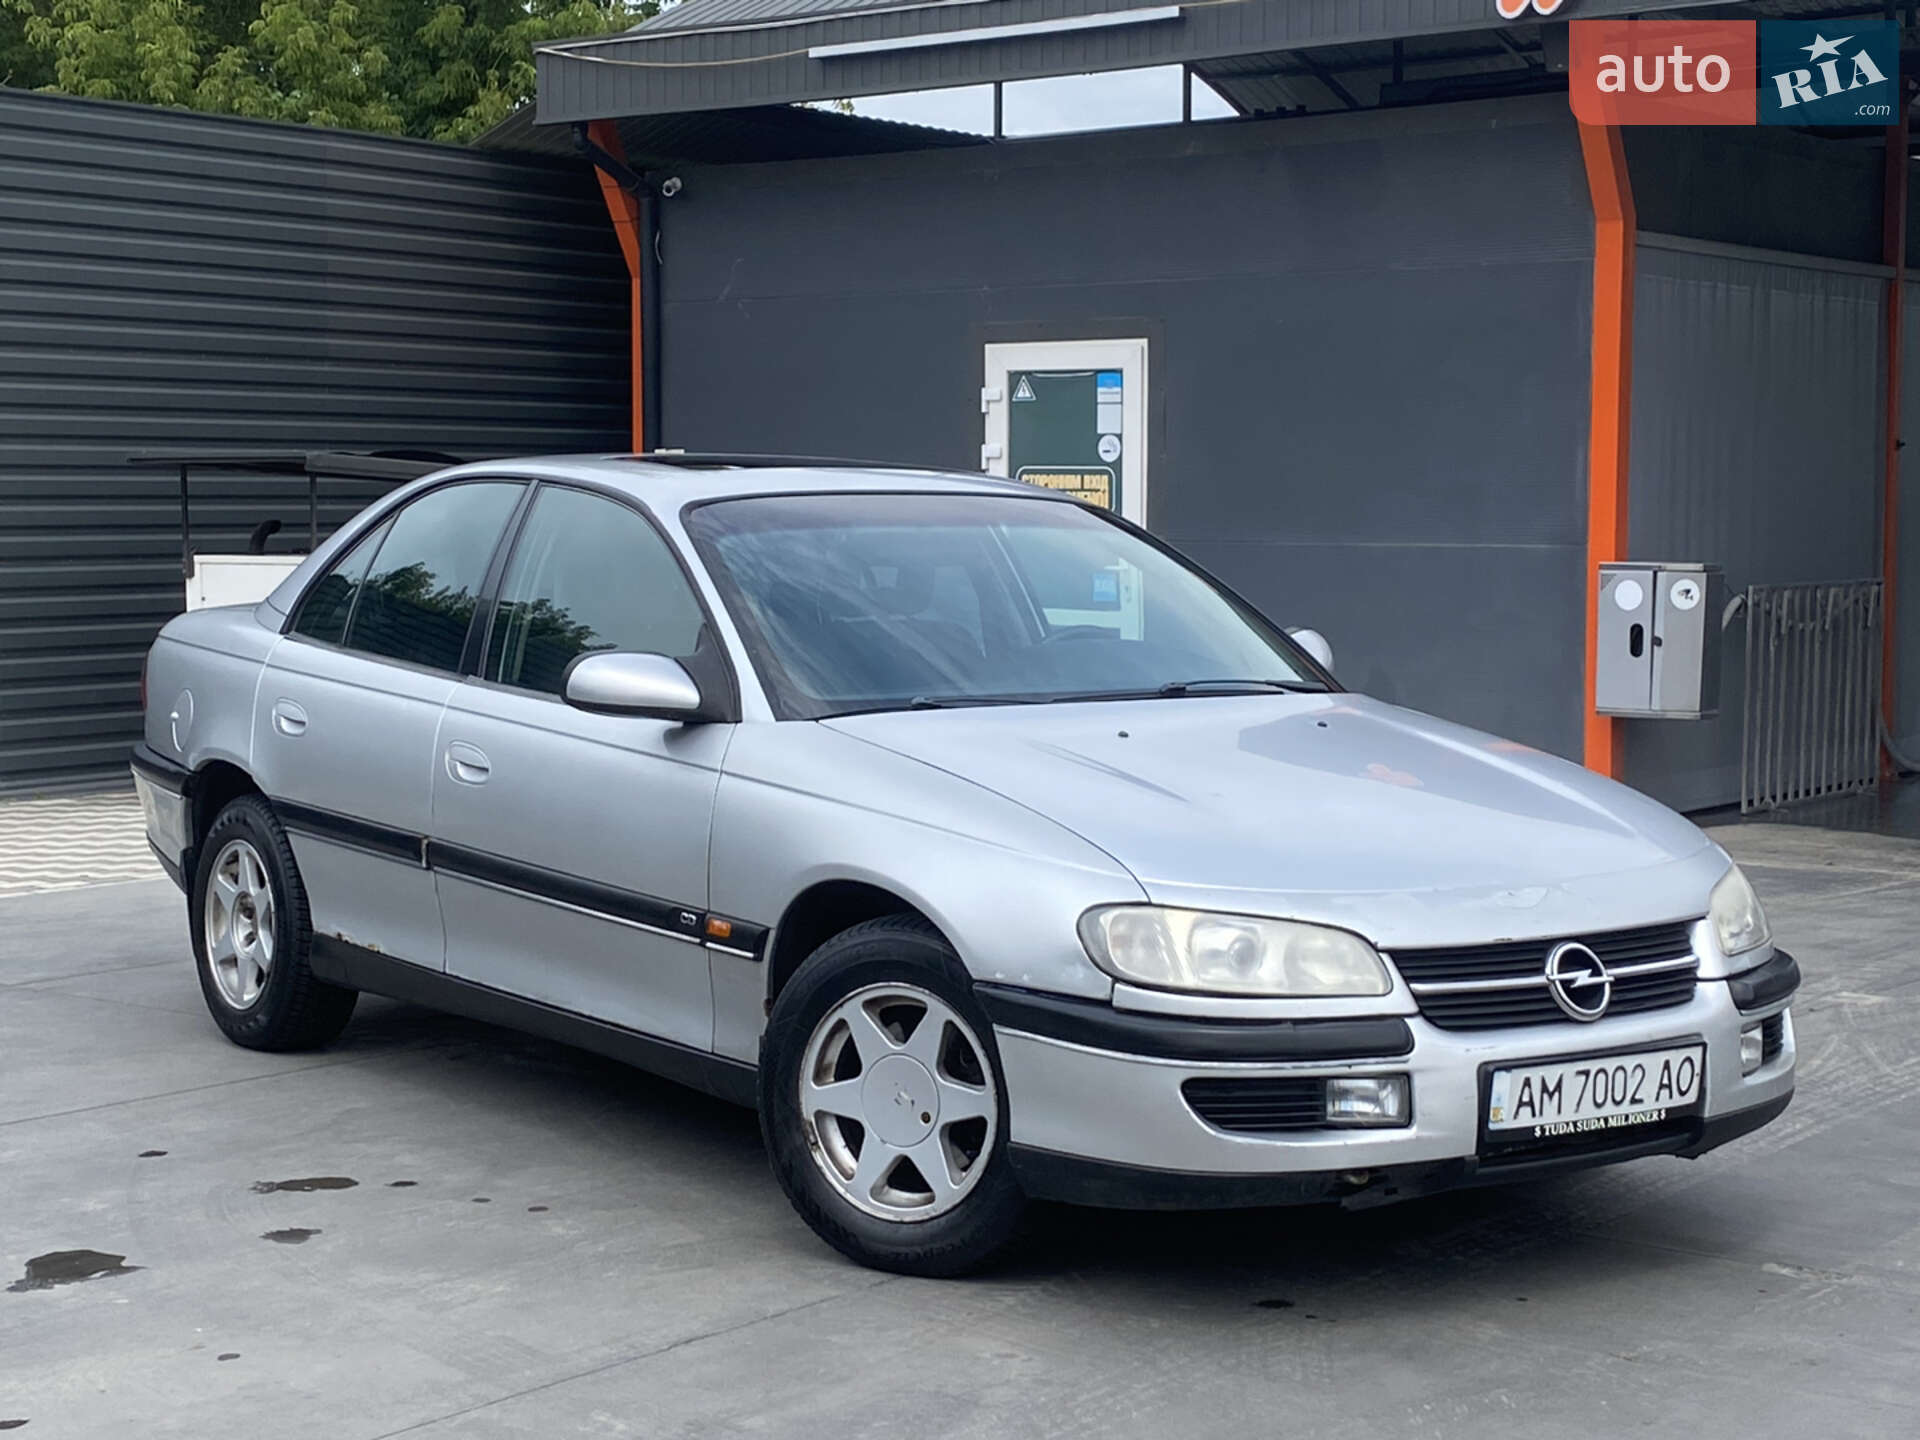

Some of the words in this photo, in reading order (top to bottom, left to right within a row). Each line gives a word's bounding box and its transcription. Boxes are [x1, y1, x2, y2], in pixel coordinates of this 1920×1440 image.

[1513, 1074, 1564, 1120] AM
[1574, 1063, 1646, 1113] 7002
[1655, 1056, 1695, 1102] AO
[1544, 1122, 1575, 1137] TUDA
[1576, 1117, 1606, 1132] SUDA
